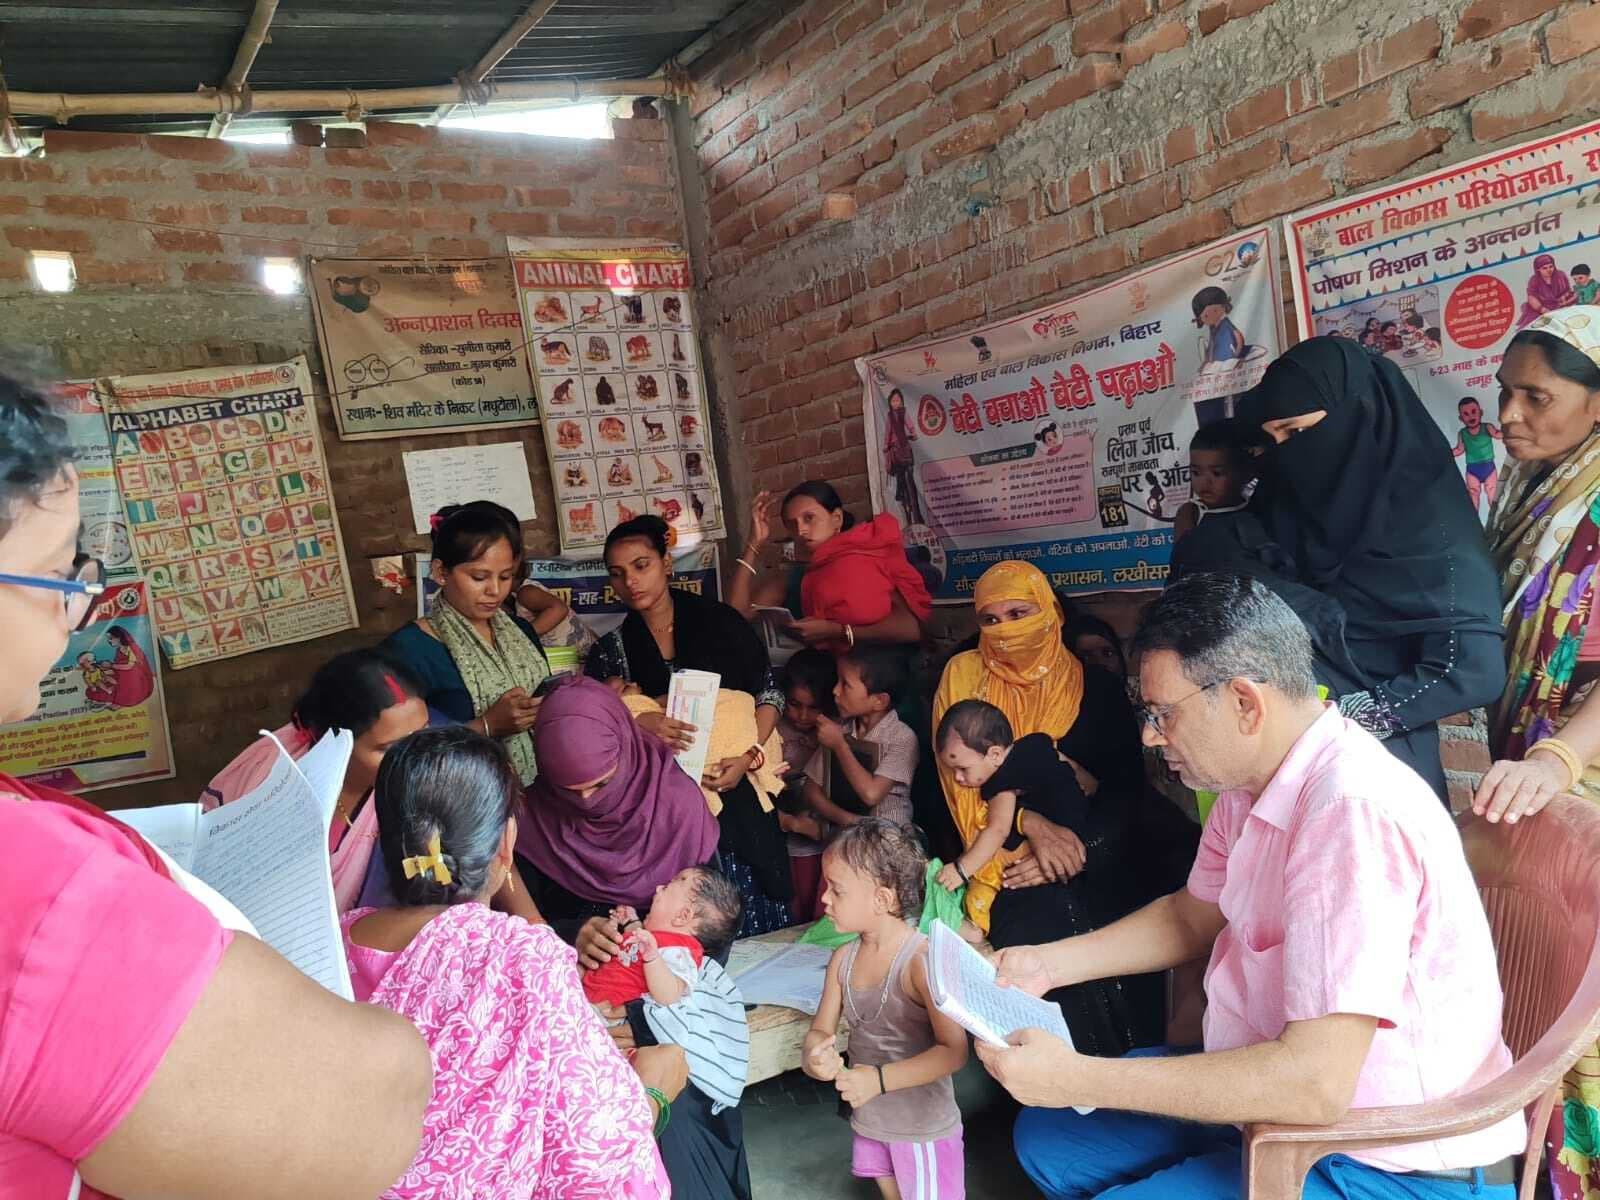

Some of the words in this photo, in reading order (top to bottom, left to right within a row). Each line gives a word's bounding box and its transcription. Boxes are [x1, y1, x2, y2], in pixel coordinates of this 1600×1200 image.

[1335, 220, 1375, 246] बाल
[1380, 196, 1448, 234] विकास
[1454, 160, 1574, 211] परियोजना,
[1312, 271, 1362, 295] पोषण
[1368, 250, 1428, 281] मिशन
[1432, 238, 1458, 262] के
[1465, 211, 1563, 255] अन्तर्गत
[523, 261, 611, 286] ANIMAL
[615, 261, 686, 287] CHART
[383, 312, 474, 335] अन्नप्राशन
[476, 308, 522, 331] दिवस
[944, 371, 978, 391] महिला
[1026, 350, 1069, 372] विकास
[1452, 360, 1473, 372] माह
[949, 392, 985, 436] बेटी
[982, 376, 1050, 428] बचाओ
[1050, 363, 1096, 412] बेटी
[1096, 341, 1177, 410] पढ़ाओ
[1465, 374, 1493, 388] समूह
[112, 402, 224, 432] ALPHABET
[231, 390, 300, 414] CHART
[383, 404, 402, 420] शिव
[434, 401, 446, 417] के
[448, 400, 477, 415] निकट
[218, 419, 238, 439] C
[266, 412, 285, 433] D
[116, 433, 138, 455] A
[168, 427, 188, 450] B
[272, 444, 295, 465] H
[1106, 437, 1138, 463] लिंग
[175, 460, 196, 482] F
[224, 452, 249, 473] G
[122, 464, 146, 489] E
[283, 476, 304, 496] L
[1120, 473, 1143, 493] पर
[186, 493, 204, 514] J
[234, 485, 255, 507] K
[291, 506, 310, 527] P
[1101, 504, 1127, 523] 181
[189, 525, 214, 547] N
[241, 515, 263, 537] O
[138, 535, 165, 556] M
[300, 537, 319, 558] T
[1074, 543, 1088, 554] को
[1151, 532, 1166, 546] को
[200, 556, 223, 579] R
[252, 548, 273, 569] S
[150, 565, 171, 589] Q
[305, 568, 328, 589] X
[256, 578, 281, 600] W
[156, 600, 180, 621] U
[206, 591, 228, 611] V
[163, 633, 186, 655] Y
[216, 623, 240, 644] Z
